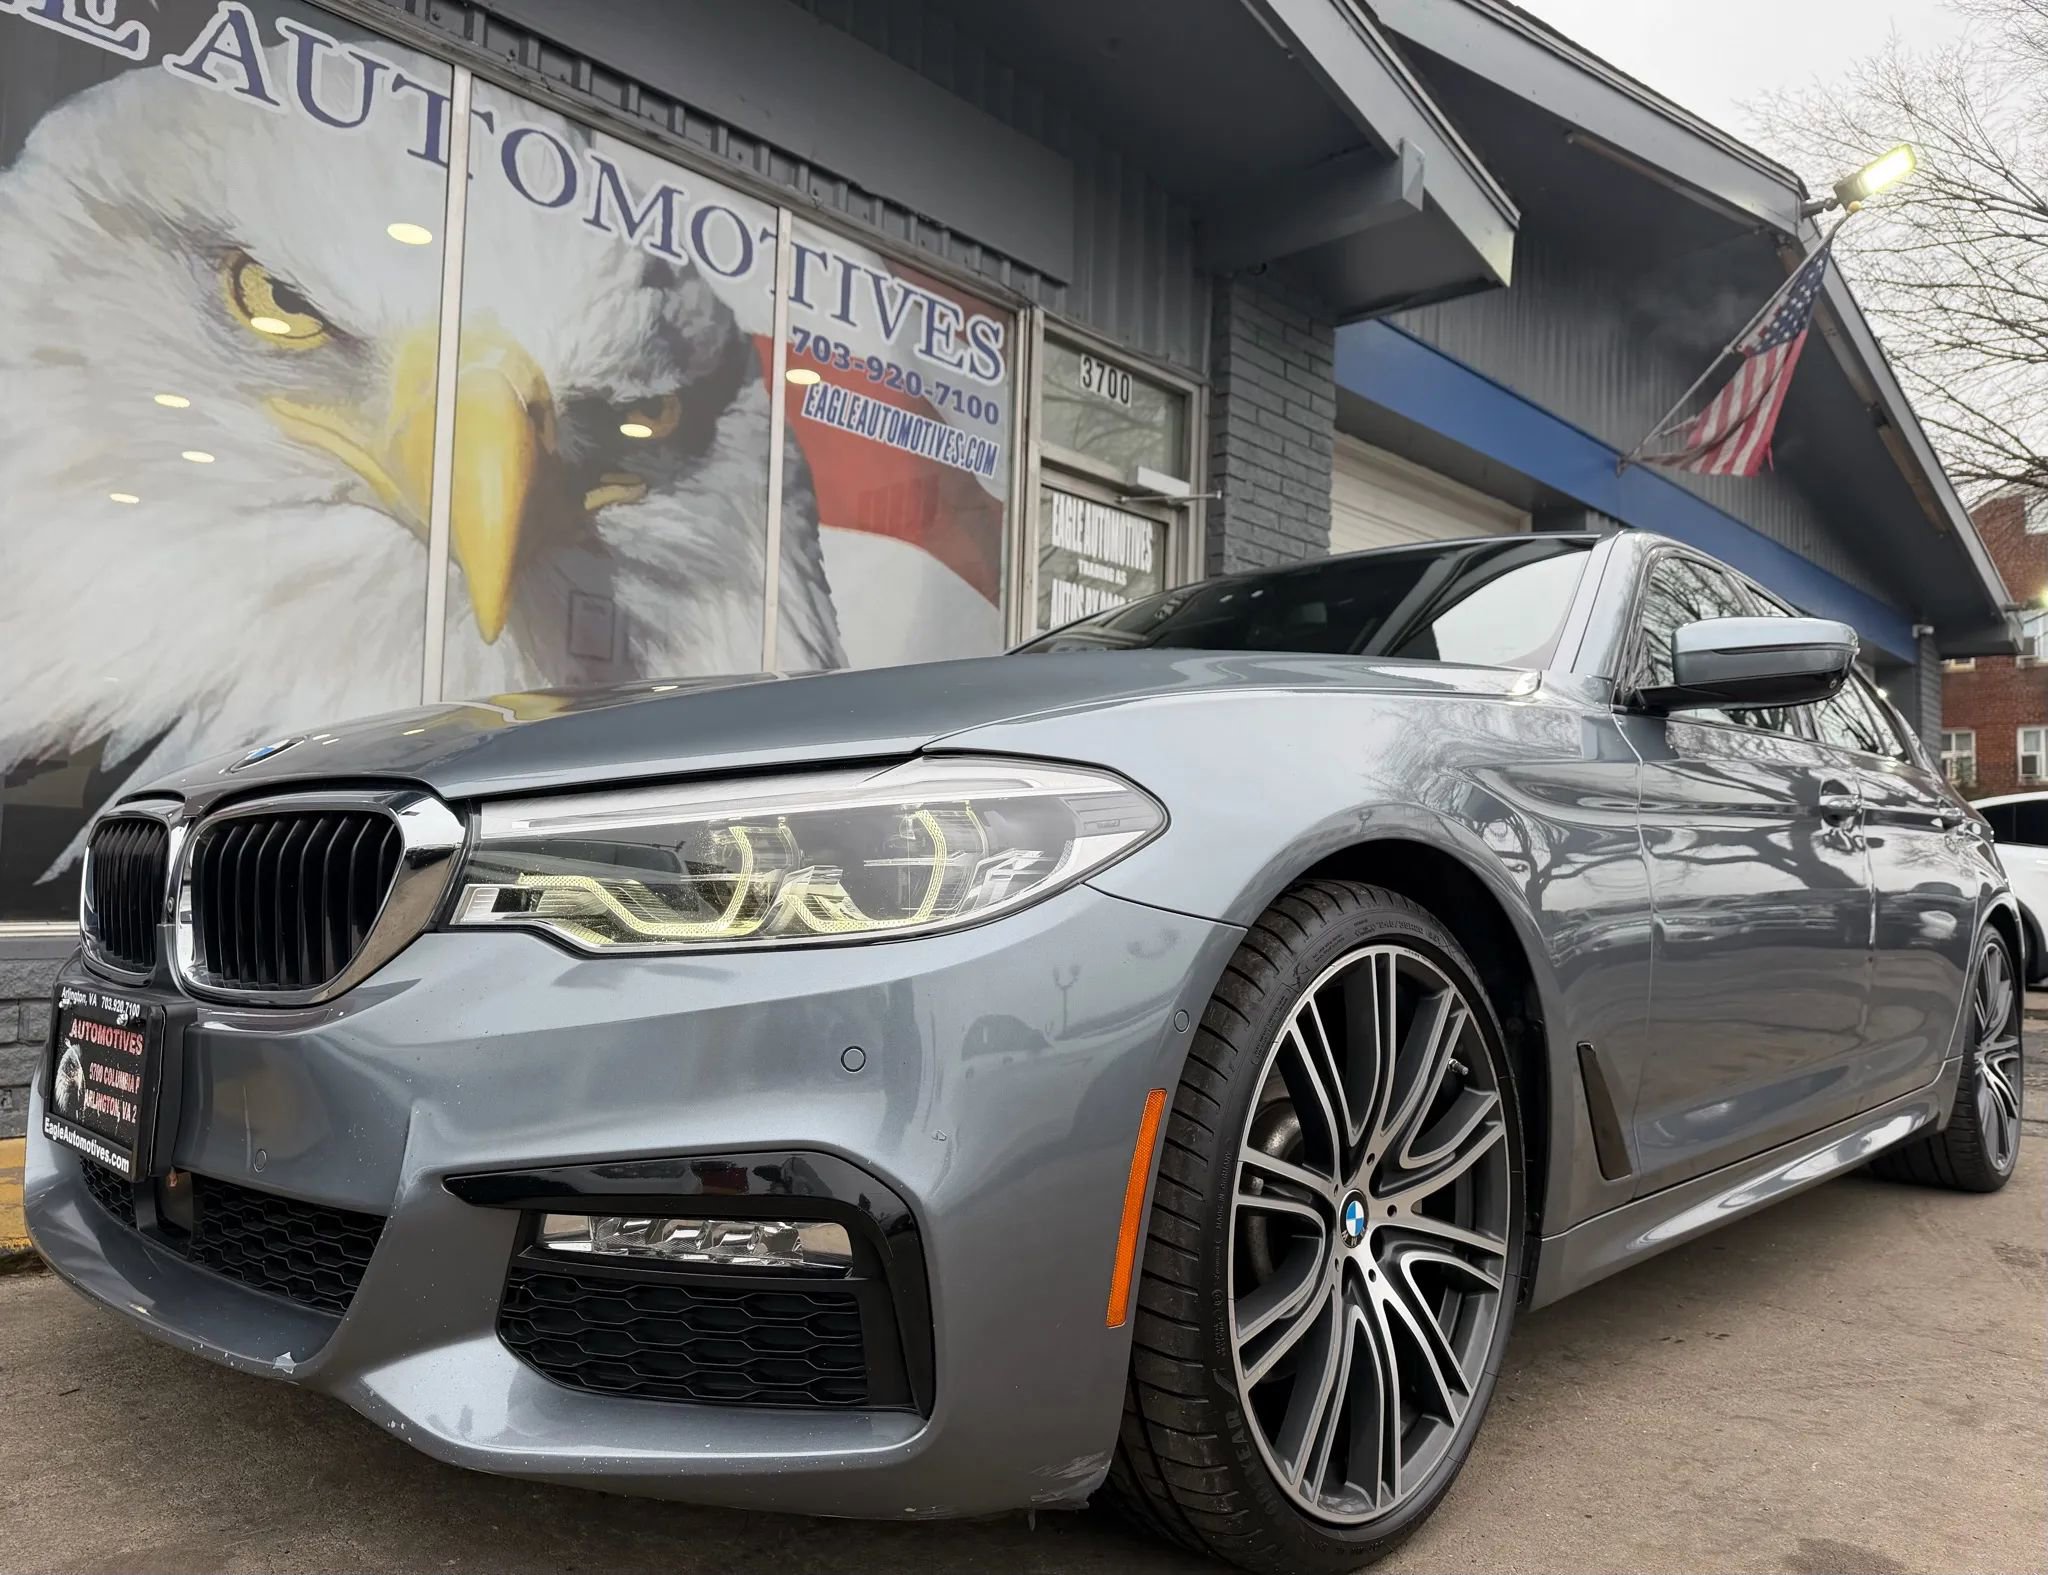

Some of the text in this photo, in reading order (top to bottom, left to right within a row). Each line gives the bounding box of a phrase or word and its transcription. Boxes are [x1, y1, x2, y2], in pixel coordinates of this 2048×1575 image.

[164, 2, 1006, 387] AUTOMOTIVES
[792, 326, 999, 425] 703-920-7100
[1082, 356, 1130, 405] 3700
[803, 382, 998, 477] EAGLEAUTOMOTIVES.COM
[89, 992, 97, 1007] VA
[70, 1017, 144, 1056] AUTOMOTIVES
[122, 1100, 131, 1122] VA
[43, 1116, 131, 1174] EagleAutomotives.com
